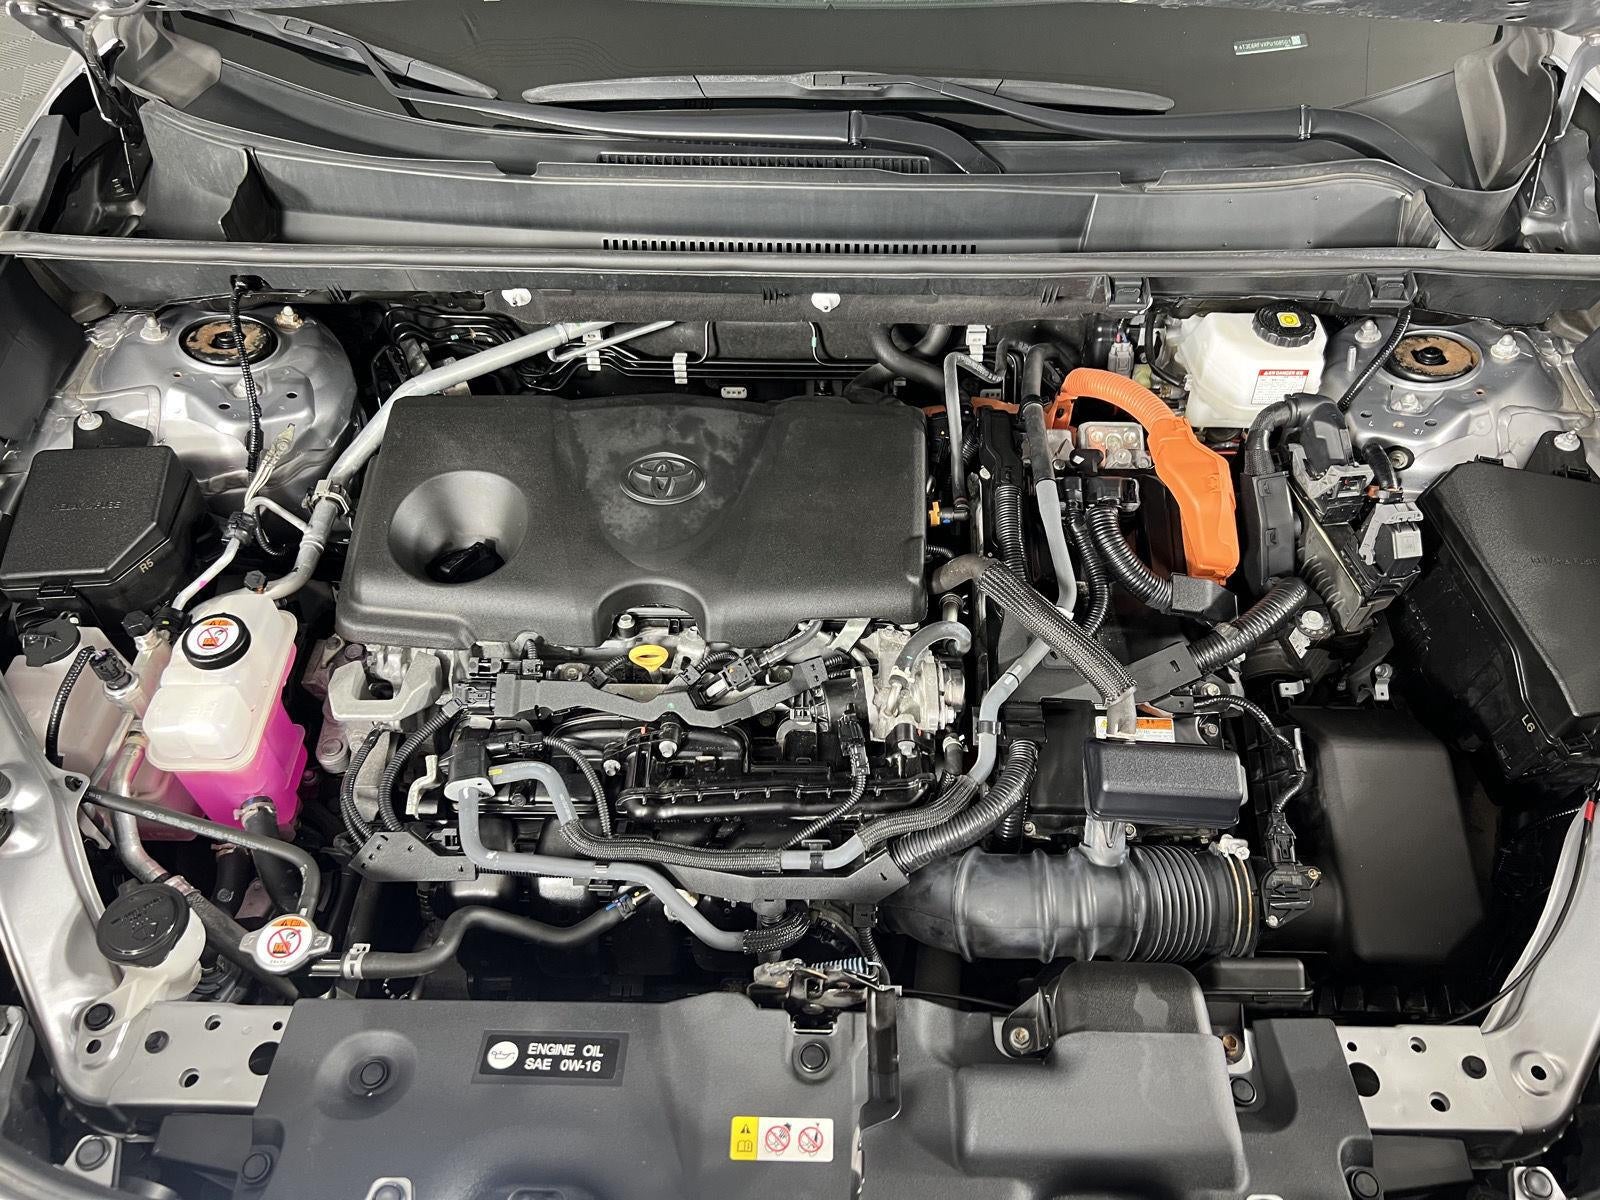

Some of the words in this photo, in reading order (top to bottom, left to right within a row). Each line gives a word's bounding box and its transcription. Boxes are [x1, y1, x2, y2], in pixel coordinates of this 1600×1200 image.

[139, 558, 154, 573] R5
[1521, 713, 1536, 733] L6
[527, 1042, 576, 1056] ENGINE
[582, 1044, 604, 1057] OIL
[524, 1057, 552, 1071] SAE
[559, 1059, 601, 1073] 0W-16
